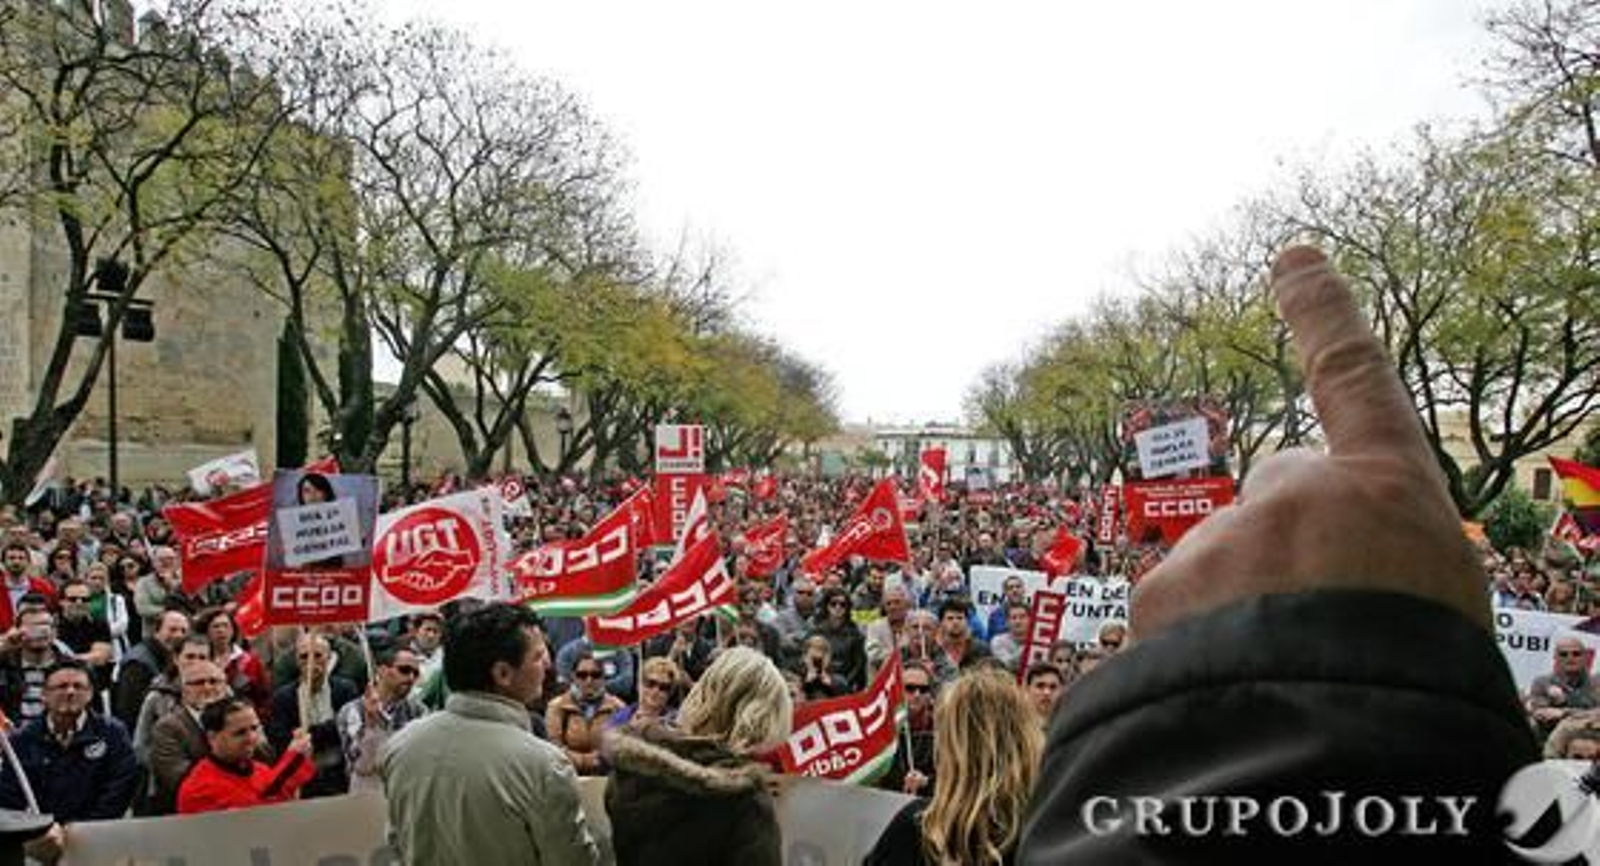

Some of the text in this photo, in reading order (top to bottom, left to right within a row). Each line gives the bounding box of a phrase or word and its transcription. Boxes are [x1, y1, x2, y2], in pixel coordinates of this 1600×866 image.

[1143, 498, 1212, 518] CCOO
[386, 518, 460, 567] UGT
[272, 584, 364, 609] CCOO
[1066, 582, 1131, 600] EN DE
